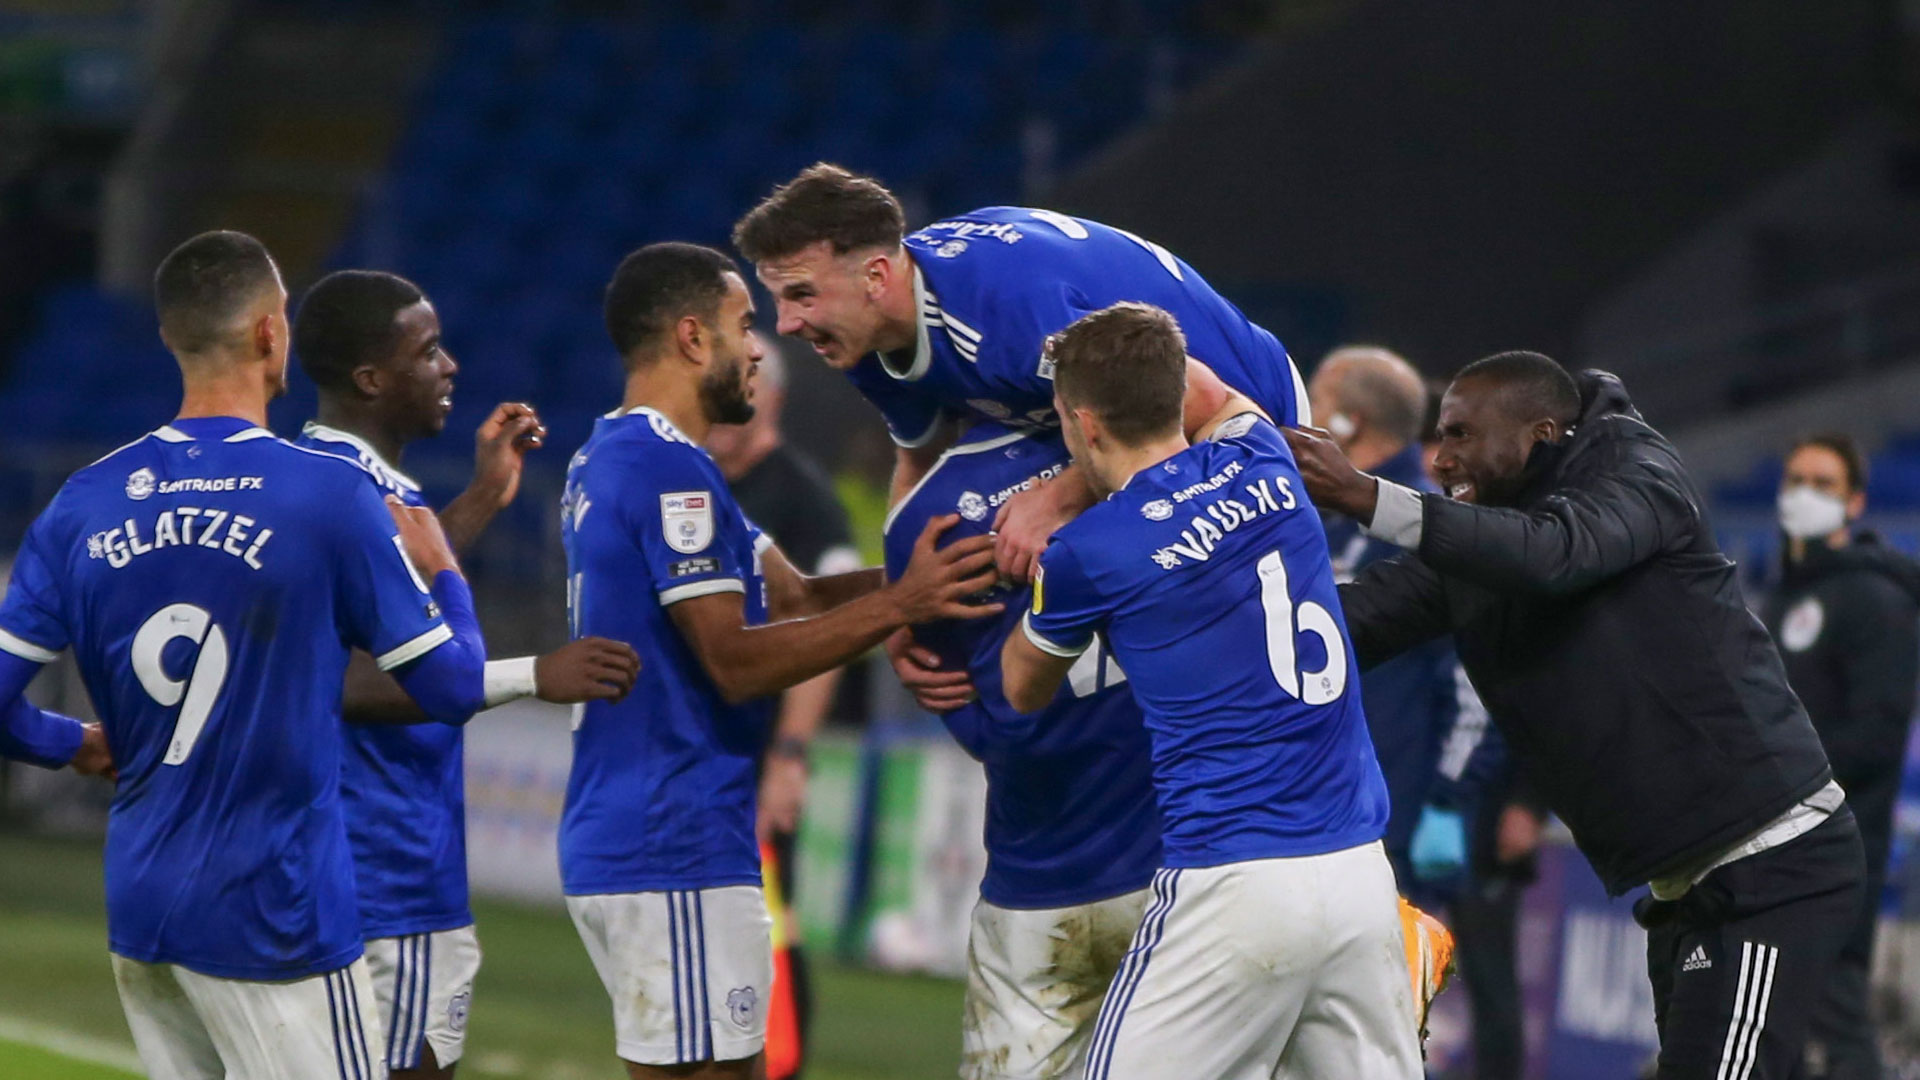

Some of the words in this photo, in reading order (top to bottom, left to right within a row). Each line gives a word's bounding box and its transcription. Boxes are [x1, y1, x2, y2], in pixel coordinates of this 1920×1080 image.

[158, 478, 236, 494] SAMTRADE
[239, 477, 263, 490] FX
[988, 463, 1062, 507] SAMTRDE
[1223, 460, 1244, 479] FX
[103, 506, 273, 570] GLATZEL
[1257, 549, 1347, 705] 6
[132, 602, 229, 766] 9
[1682, 959, 1712, 971] adidas
